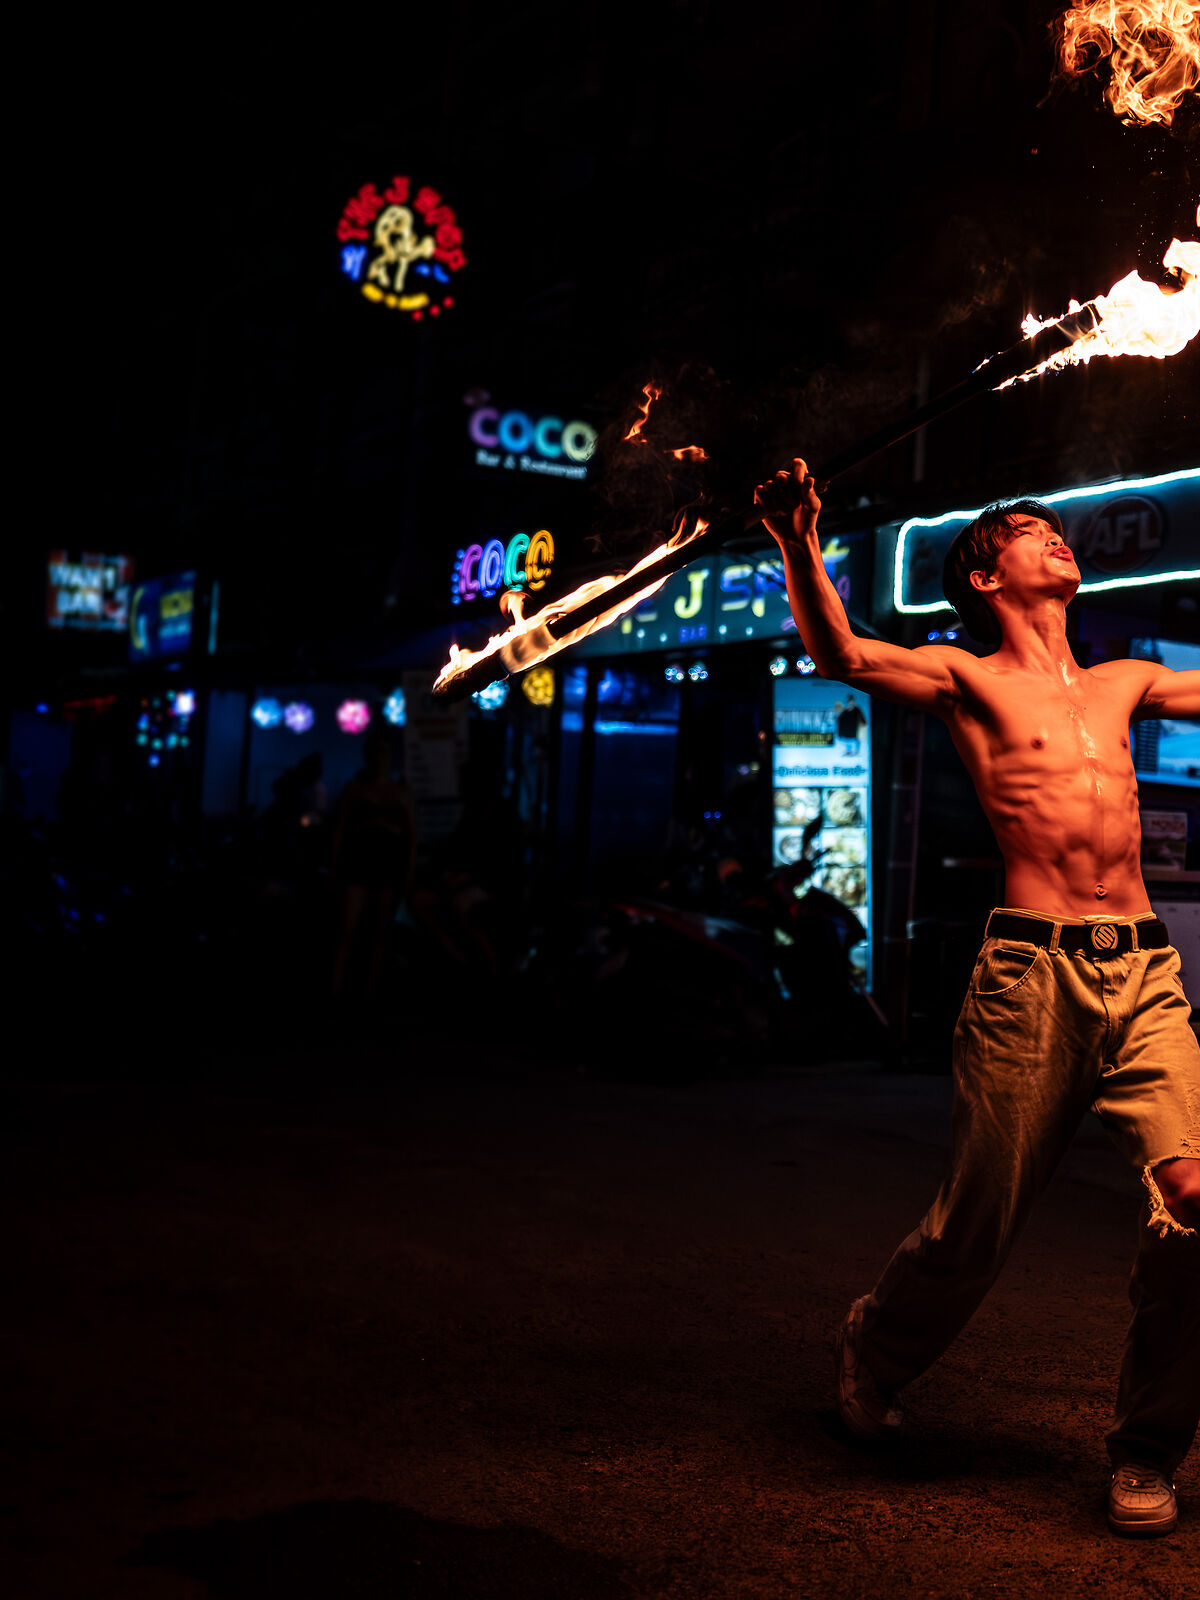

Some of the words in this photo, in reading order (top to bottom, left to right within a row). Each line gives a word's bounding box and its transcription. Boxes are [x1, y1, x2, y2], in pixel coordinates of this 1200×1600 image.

[466, 405, 599, 462] COCO
[1083, 507, 1163, 560] AFL
[459, 529, 554, 601] COCO
[673, 568, 711, 620] J
